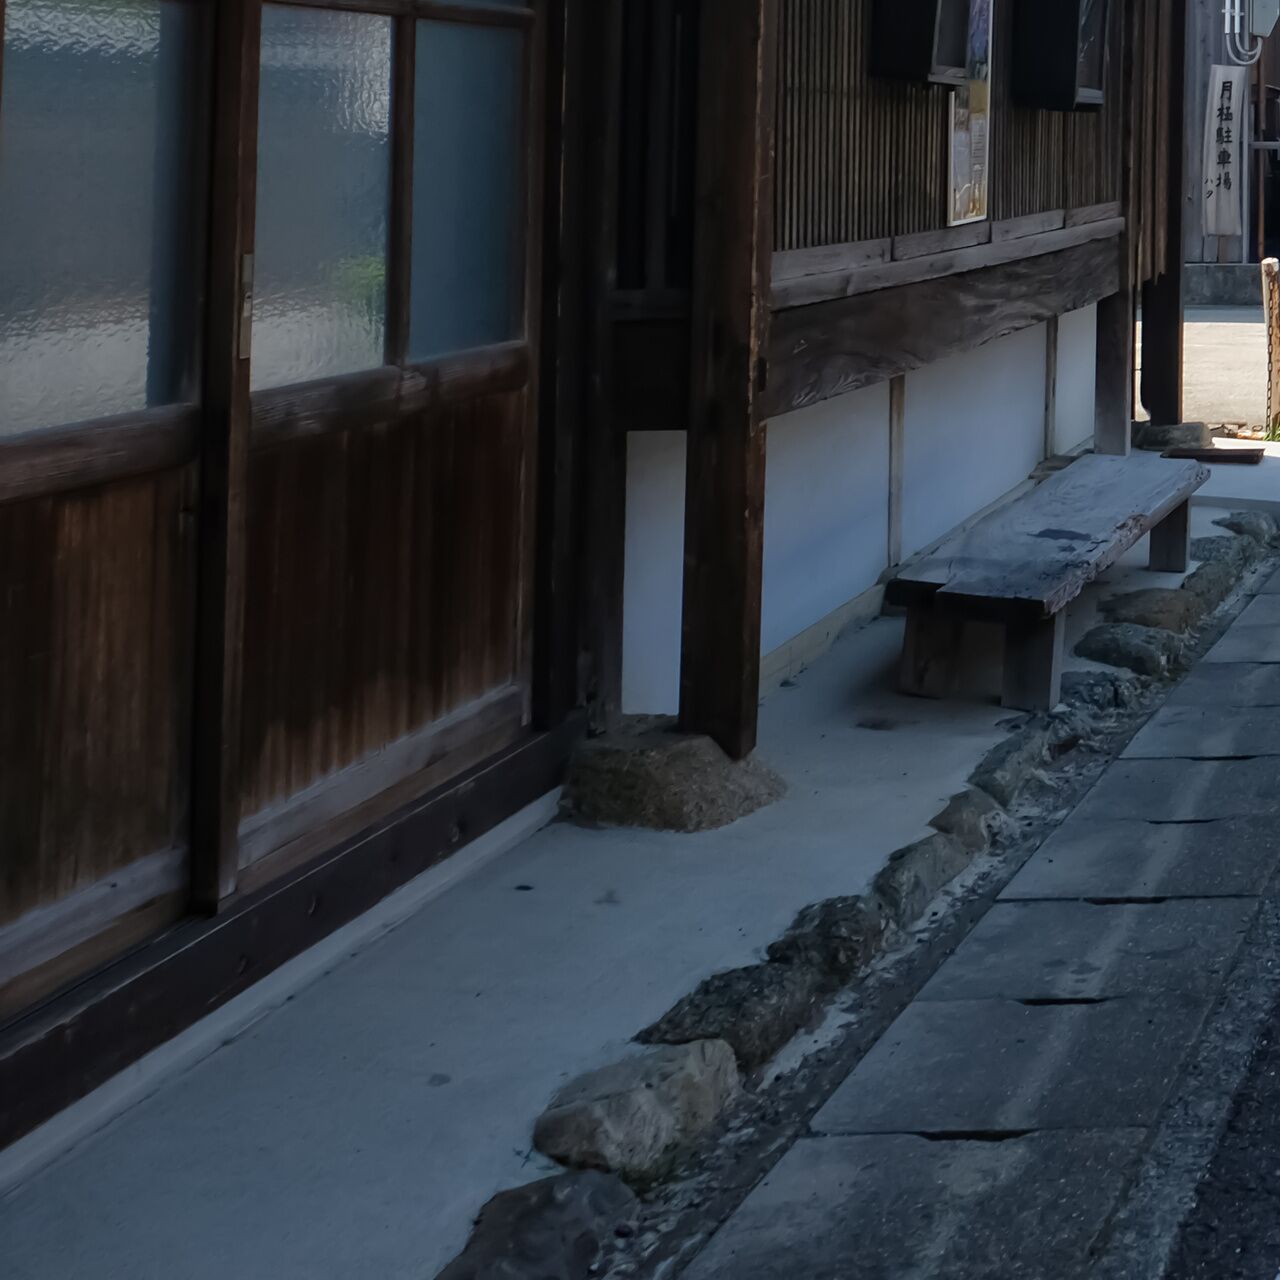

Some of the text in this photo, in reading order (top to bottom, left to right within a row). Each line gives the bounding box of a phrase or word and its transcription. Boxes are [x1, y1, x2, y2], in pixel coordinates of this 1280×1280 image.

[1215, 79, 1234, 191] 月極駐車場
